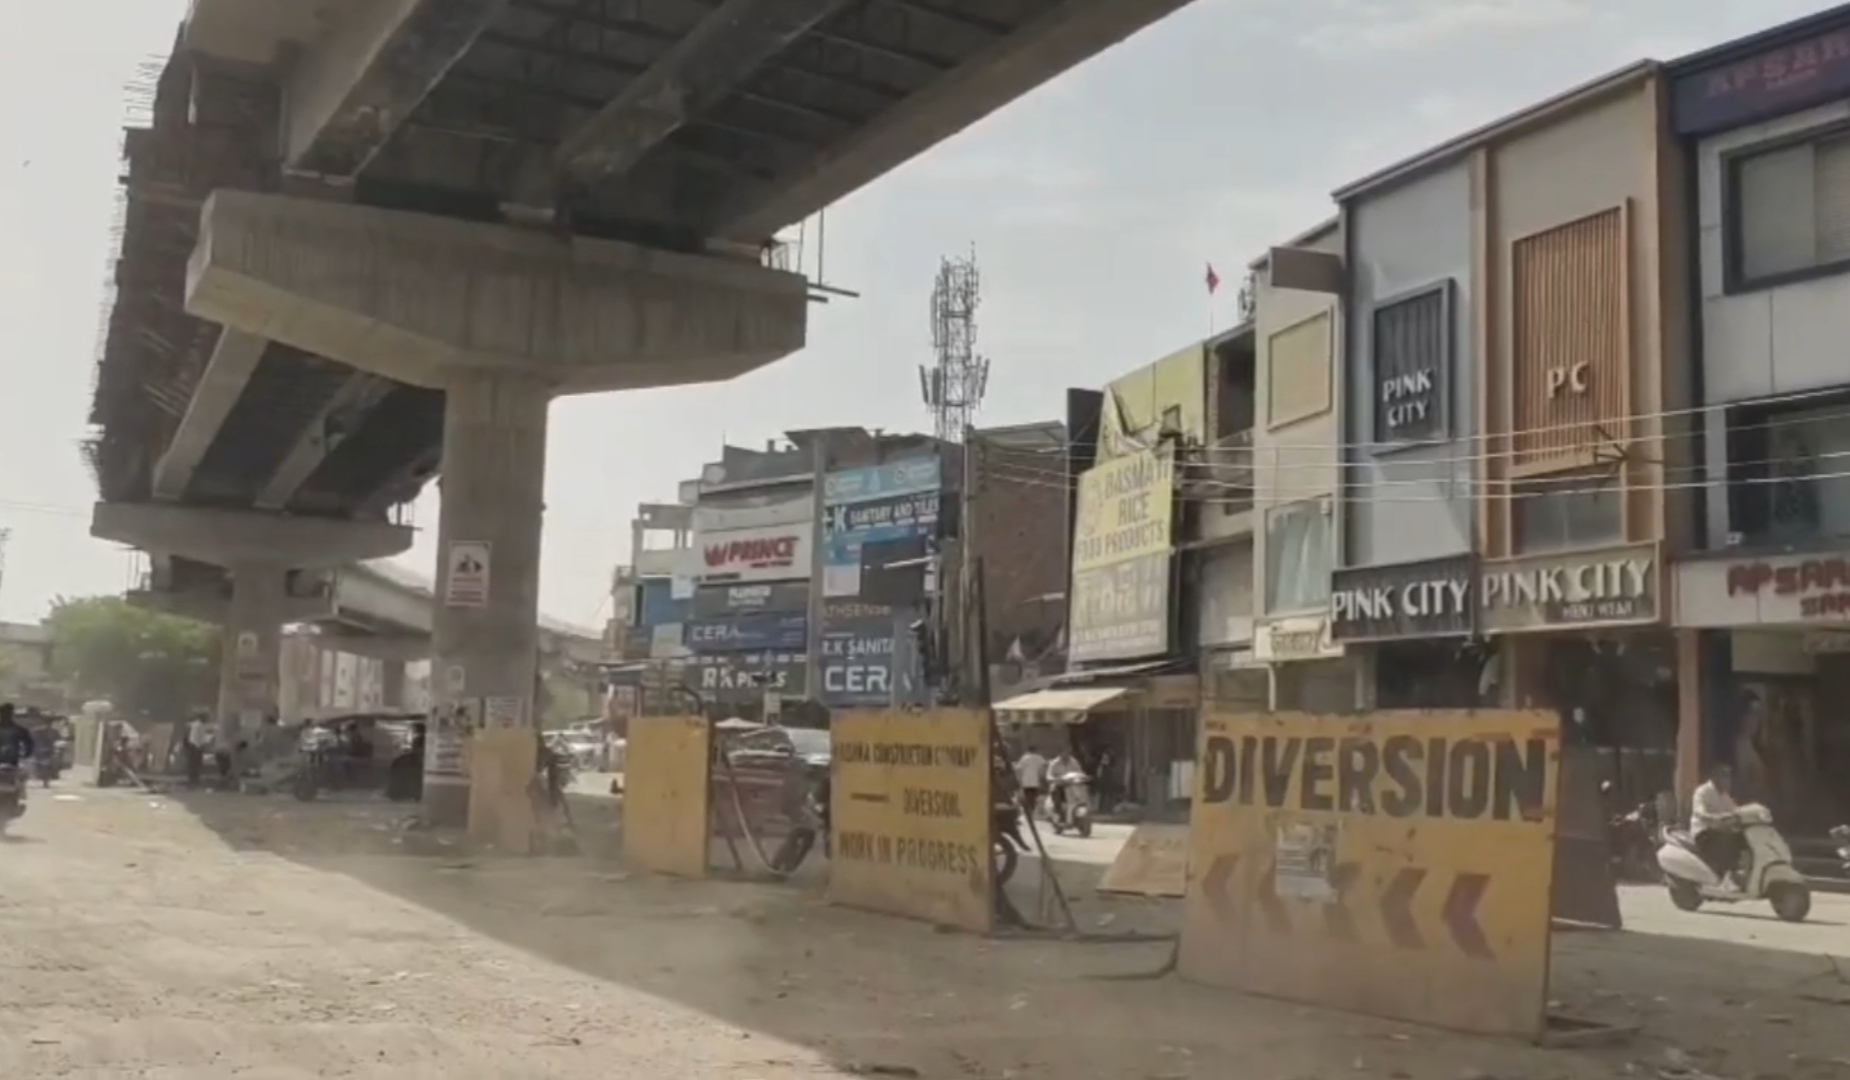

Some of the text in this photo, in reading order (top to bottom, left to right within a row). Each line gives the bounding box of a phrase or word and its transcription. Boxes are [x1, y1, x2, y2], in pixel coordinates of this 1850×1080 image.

[1383, 368, 1432, 402] PINK
[1387, 401, 1427, 427] CITY
[727, 535, 799, 563] PRINCE
[1481, 559, 1652, 608] PINK CITY
[1727, 559, 1850, 598] APSAR
[1332, 579, 1469, 622] PINK CITY
[1203, 735, 1547, 822] DIVERSION
[897, 835, 978, 875] PROGRESS
